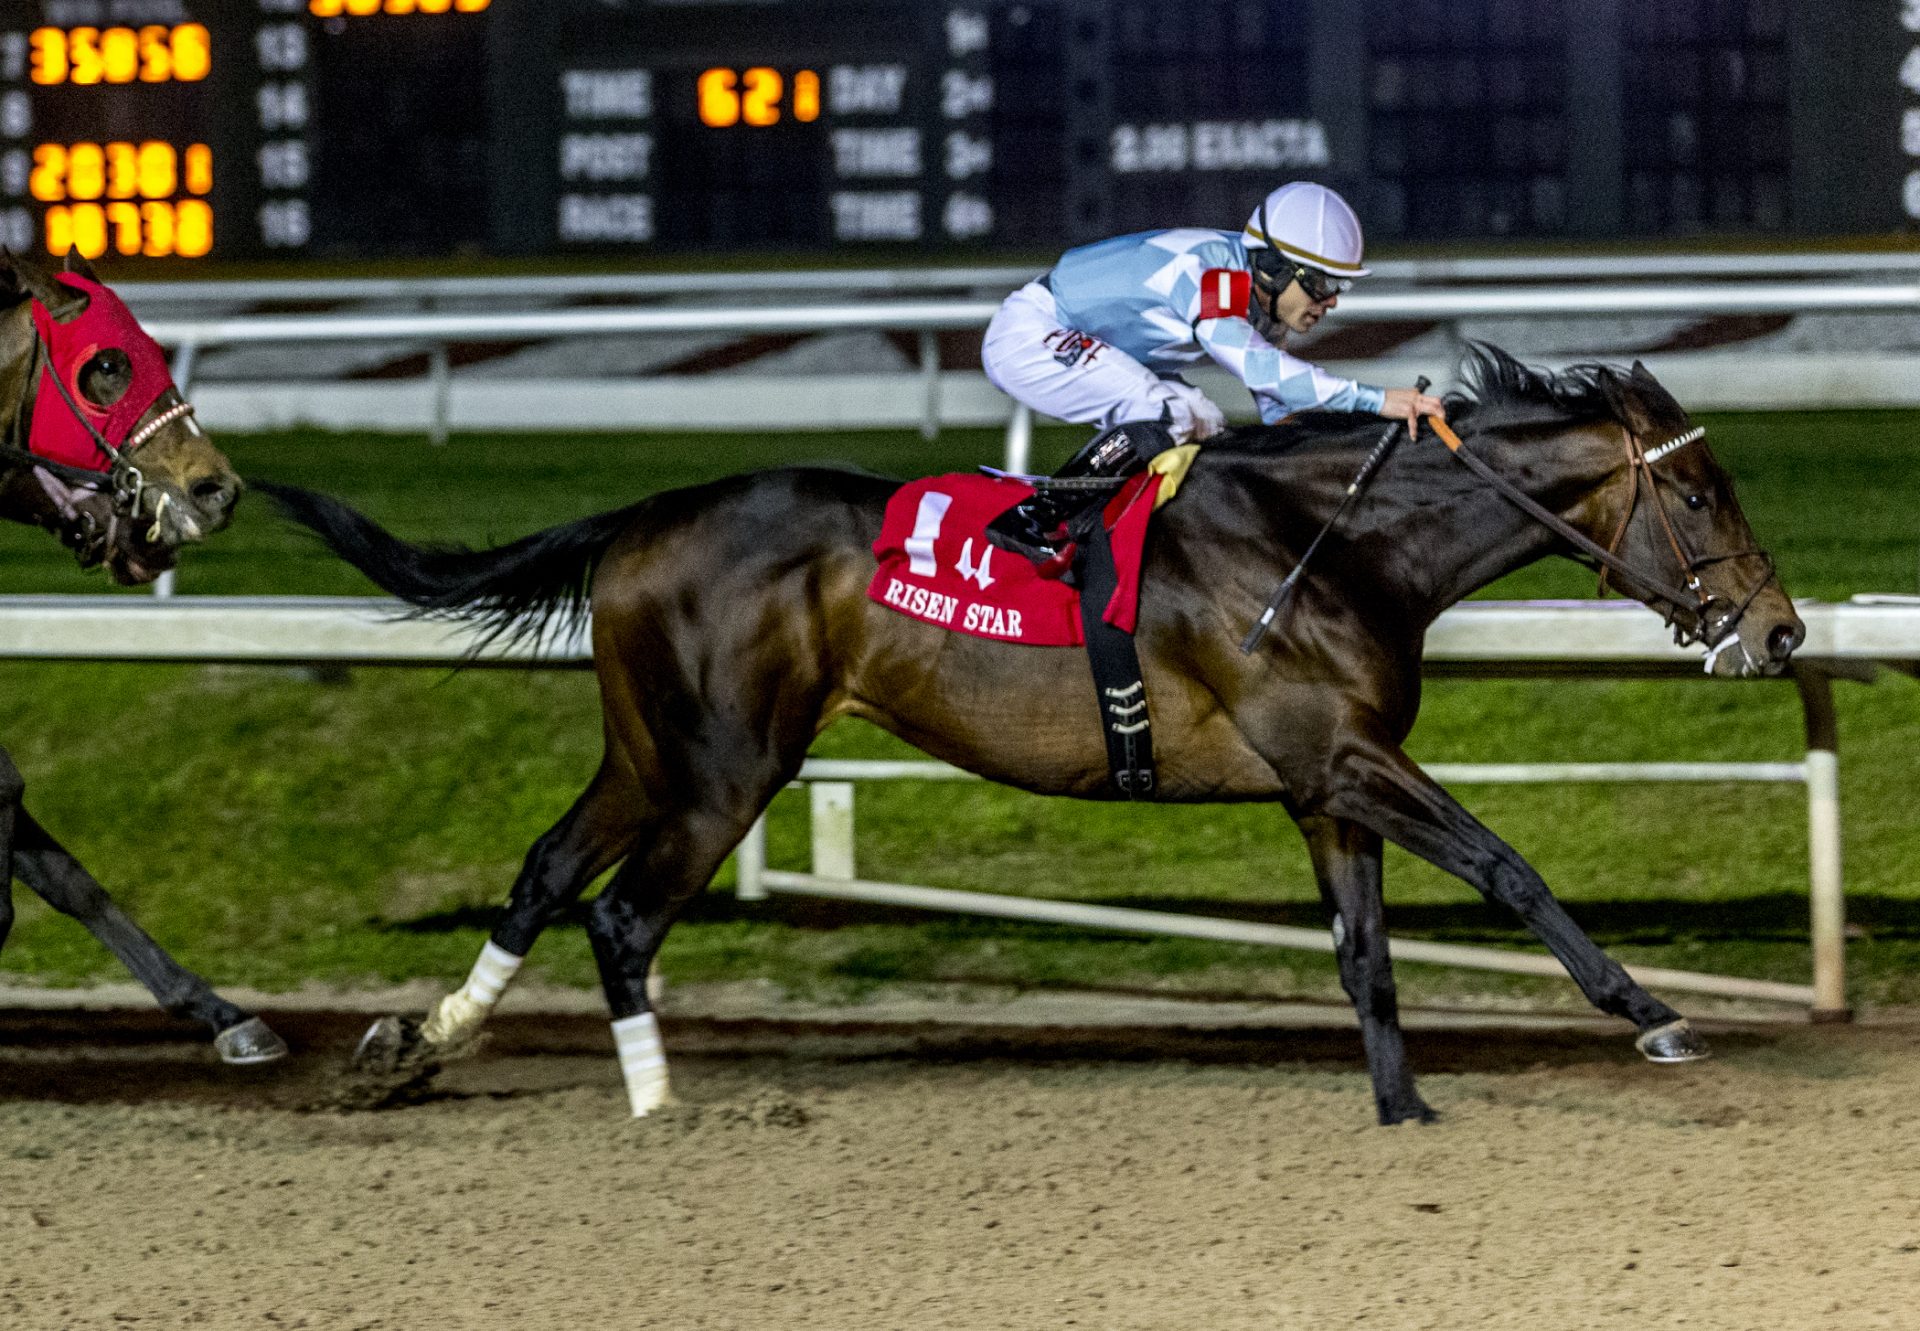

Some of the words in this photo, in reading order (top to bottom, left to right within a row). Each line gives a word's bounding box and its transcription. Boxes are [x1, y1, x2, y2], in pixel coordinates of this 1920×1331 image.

[829, 65, 906, 114] DAY
[561, 134, 652, 180] POST
[1218, 271, 1231, 309] 1
[904, 491, 953, 578] 1
[883, 577, 959, 624] RISEN
[962, 602, 1023, 638] STAR
